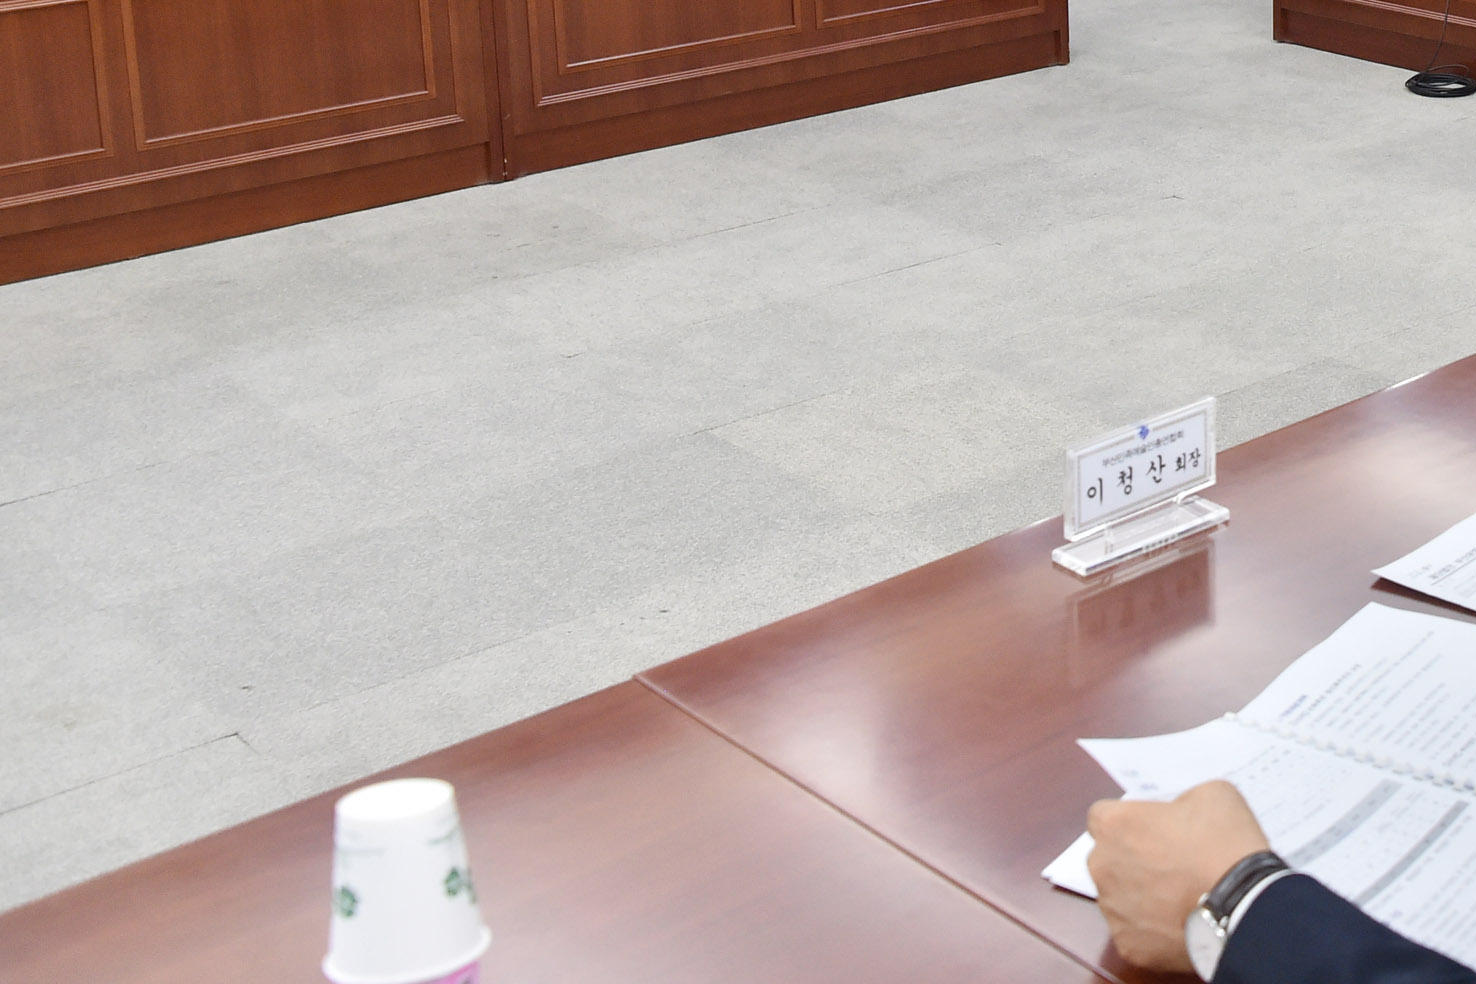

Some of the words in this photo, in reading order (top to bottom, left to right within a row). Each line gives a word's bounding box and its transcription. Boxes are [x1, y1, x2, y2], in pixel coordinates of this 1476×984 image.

[1087, 477, 1104, 505] 이
[1116, 466, 1134, 496] 청
[1145, 454, 1167, 484] 산
[1174, 447, 1202, 472] 회장
